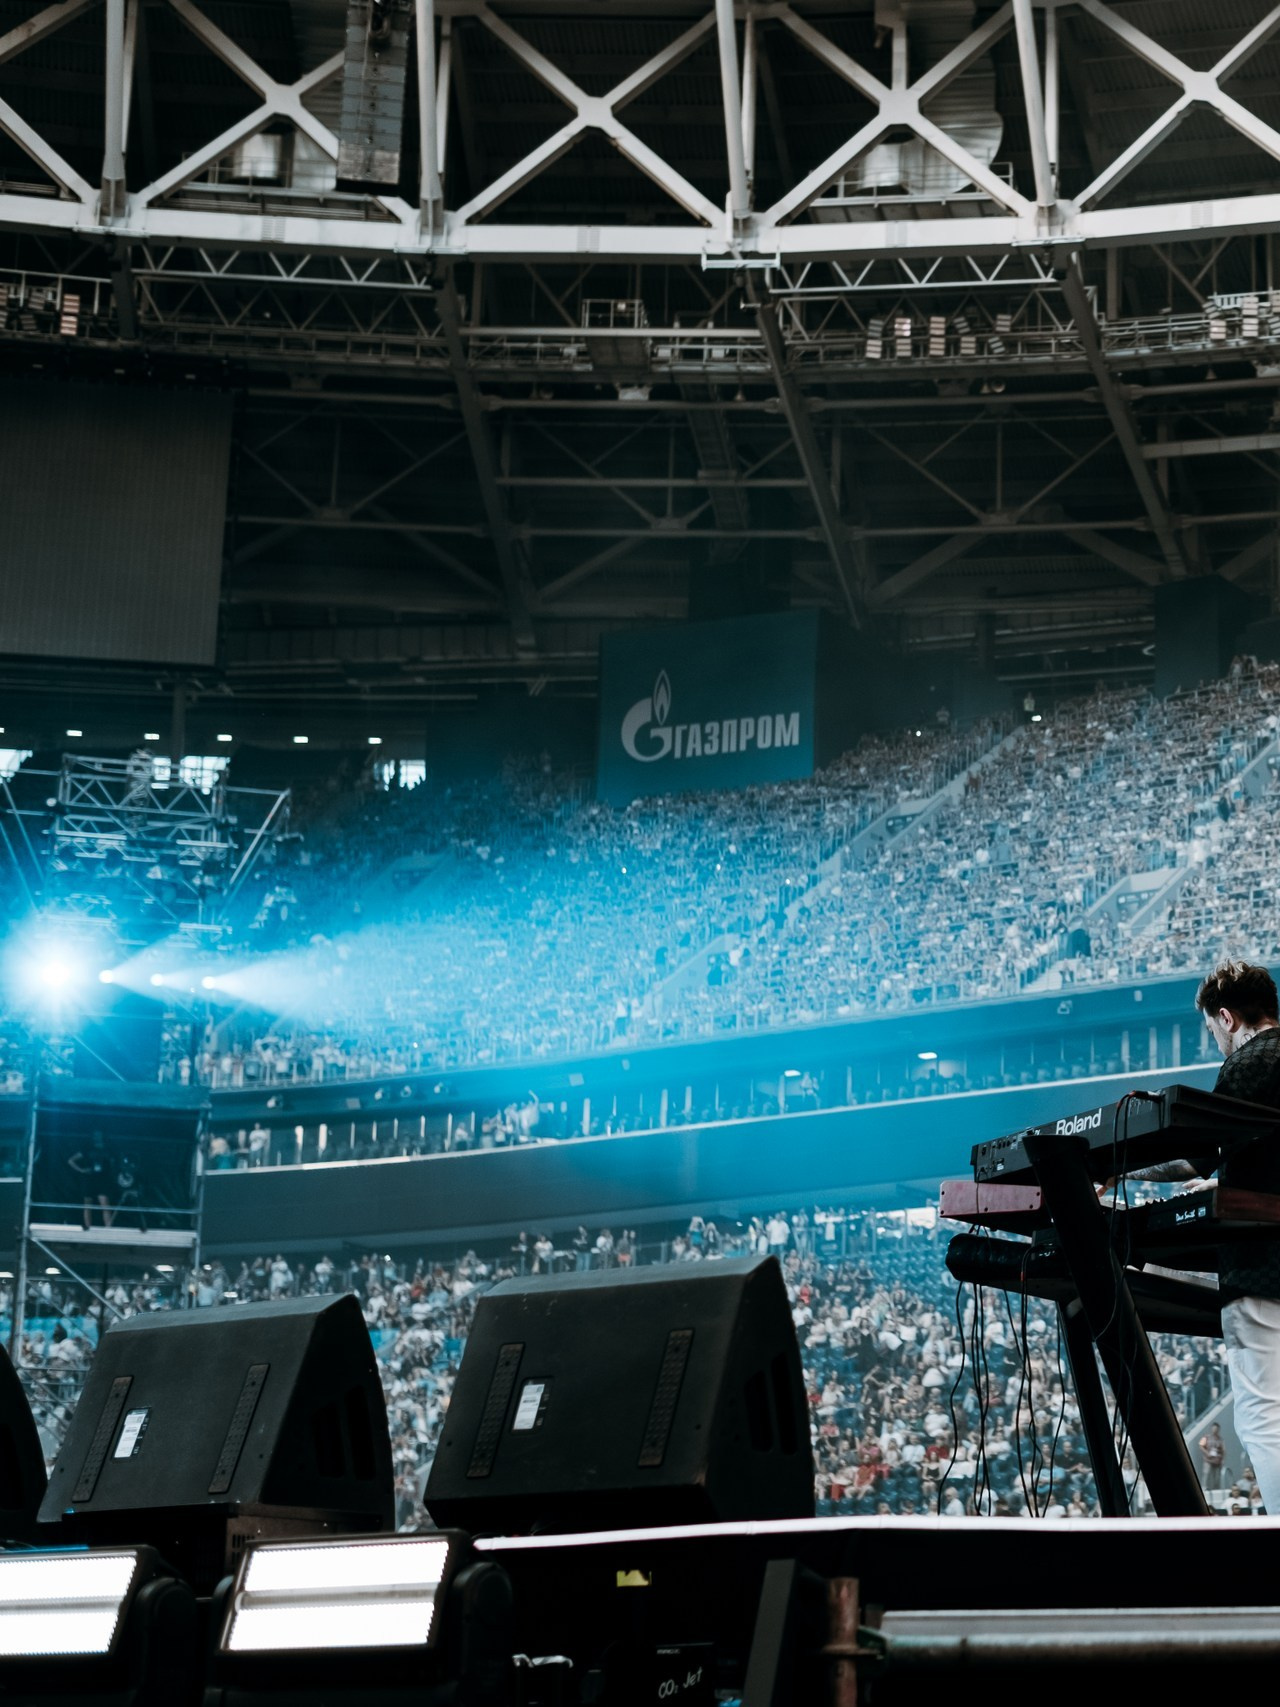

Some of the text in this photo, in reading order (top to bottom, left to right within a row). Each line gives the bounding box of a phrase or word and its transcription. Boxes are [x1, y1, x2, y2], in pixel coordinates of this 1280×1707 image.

[673, 712, 800, 759] ГАЗПРОМ
[1055, 1107, 1102, 1136] Roland
[682, 1666, 704, 1689] Jet
